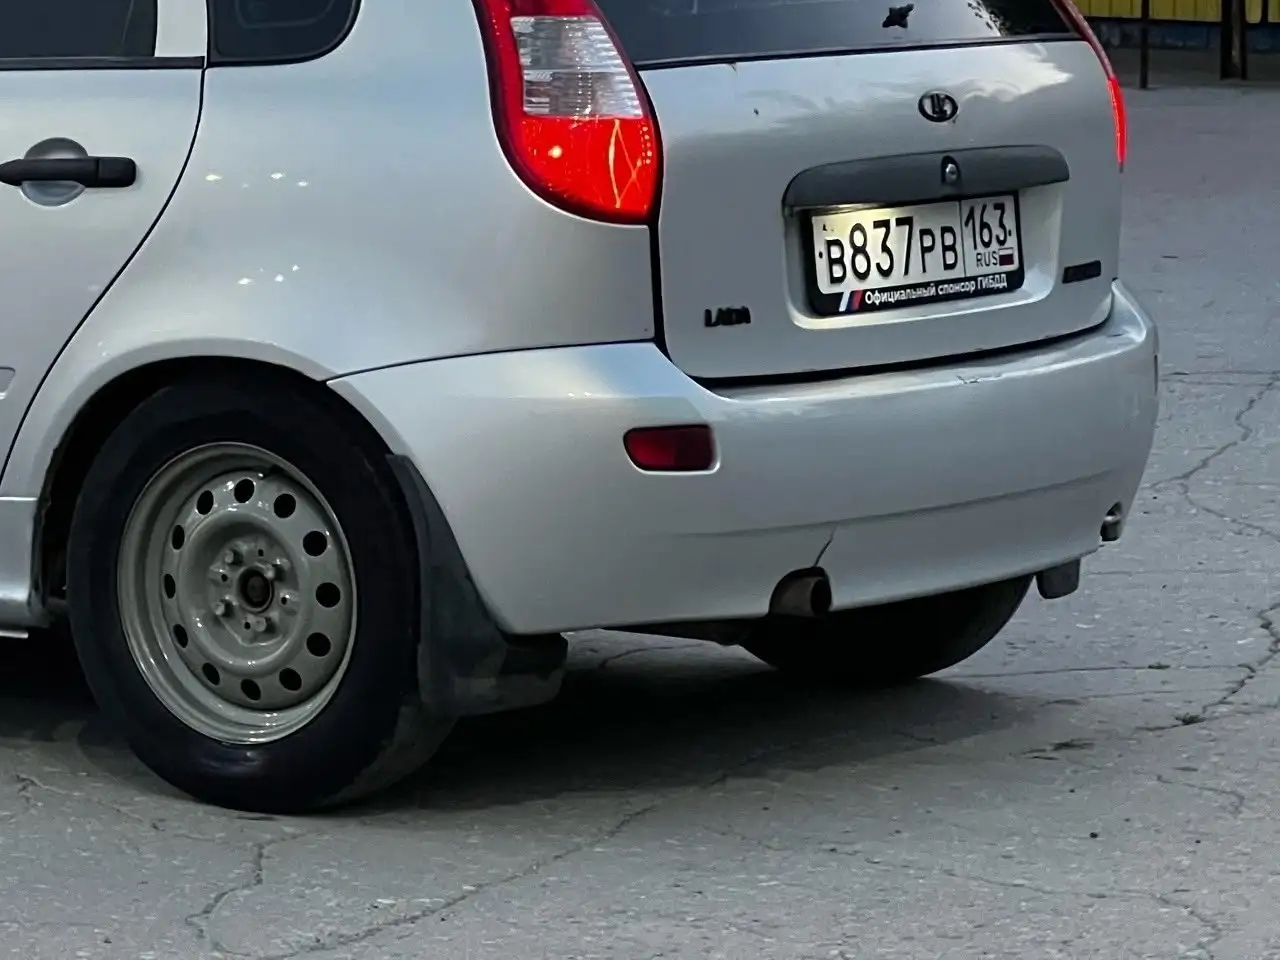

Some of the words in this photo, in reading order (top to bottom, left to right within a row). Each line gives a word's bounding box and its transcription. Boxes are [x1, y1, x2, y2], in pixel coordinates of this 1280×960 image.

[826, 216, 958, 285] В837РВ
[965, 203, 1008, 250] 163
[976, 250, 1000, 267] RUS
[865, 283, 937, 306] Официальный
[938, 280, 976, 296] спонсор
[977, 274, 1008, 290] ГИБДД
